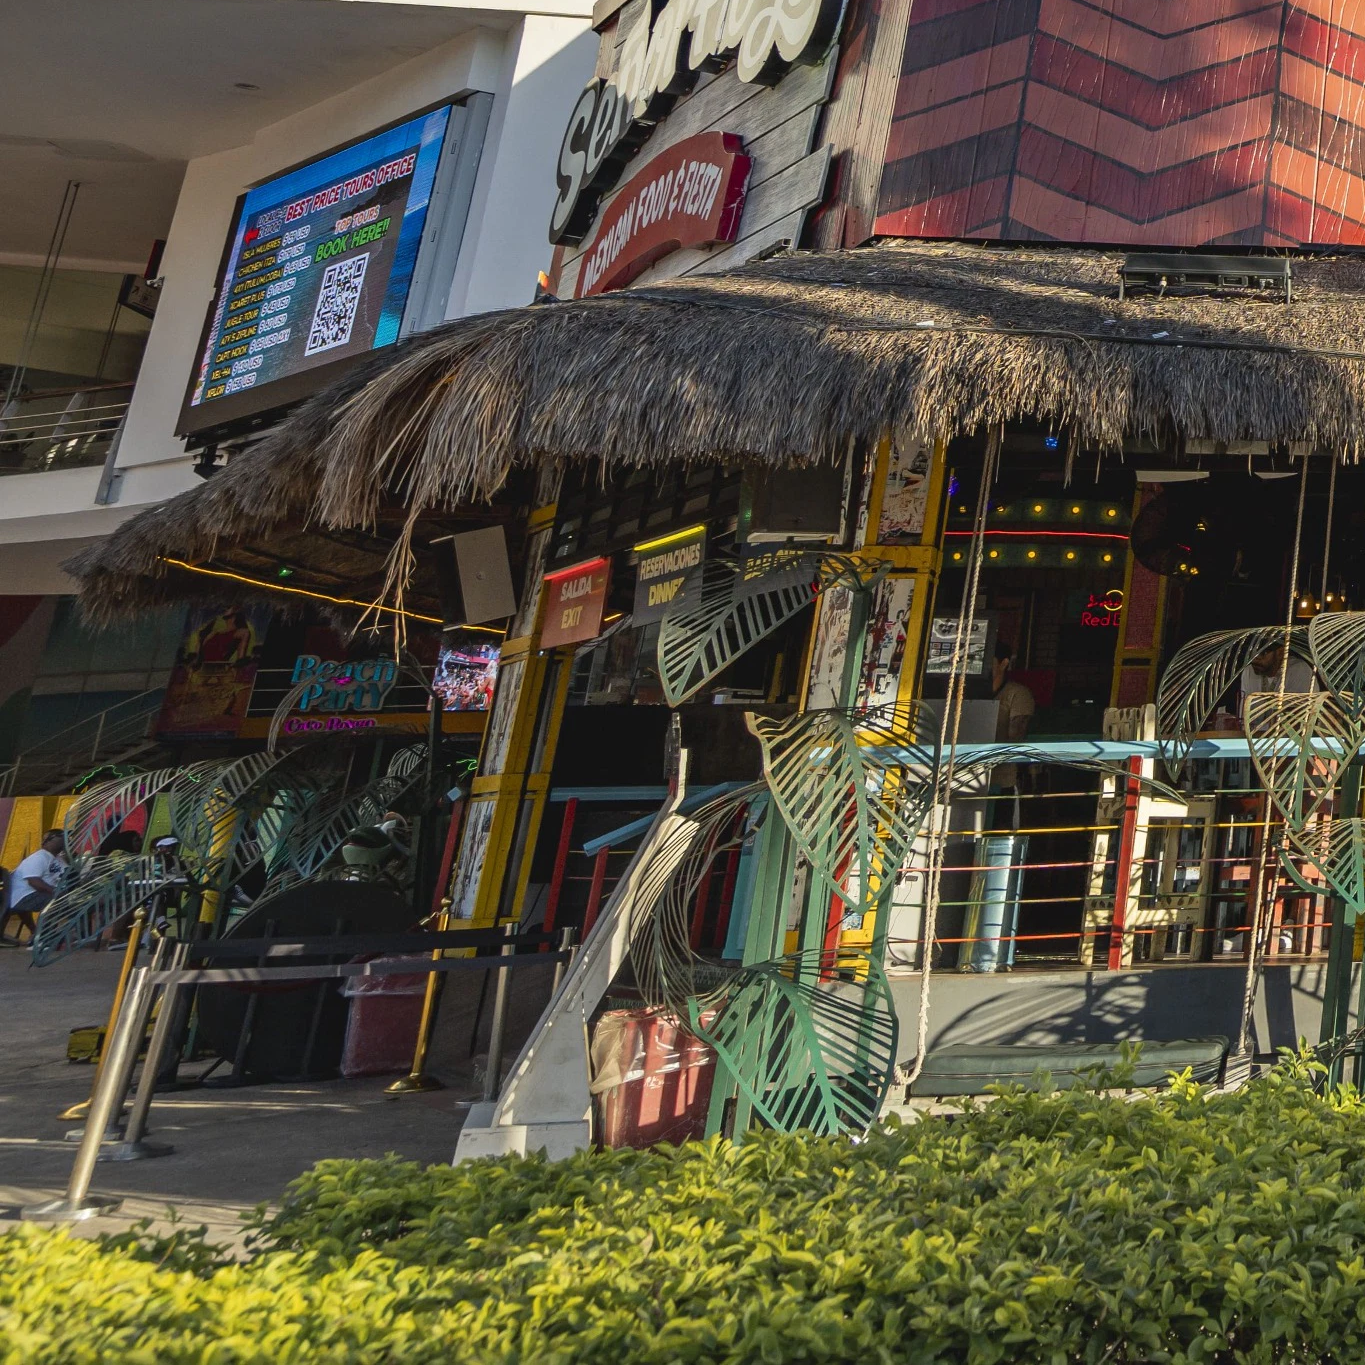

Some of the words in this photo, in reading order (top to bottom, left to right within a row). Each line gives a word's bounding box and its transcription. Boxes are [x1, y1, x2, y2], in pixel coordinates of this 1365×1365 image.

[284, 195, 314, 224] BEST
[310, 183, 343, 214] PRICE
[340, 168, 378, 201] TOURS
[375, 152, 417, 187] OFFICE
[333, 214, 354, 236] TOP
[351, 203, 382, 229] TOURS
[582, 198, 634, 296] MEXICAN
[636, 177, 672, 229] FOOD
[682, 158, 724, 222] FIESTA
[314, 233, 350, 263] BOOK
[350, 217, 391, 249] HERE!!
[639, 542, 701, 583] RESERVACIONES
[560, 574, 592, 602] SALIDA
[560, 604, 583, 629] EXIT
[1080, 611, 1111, 627] Red
[290, 655, 396, 685] Beach
